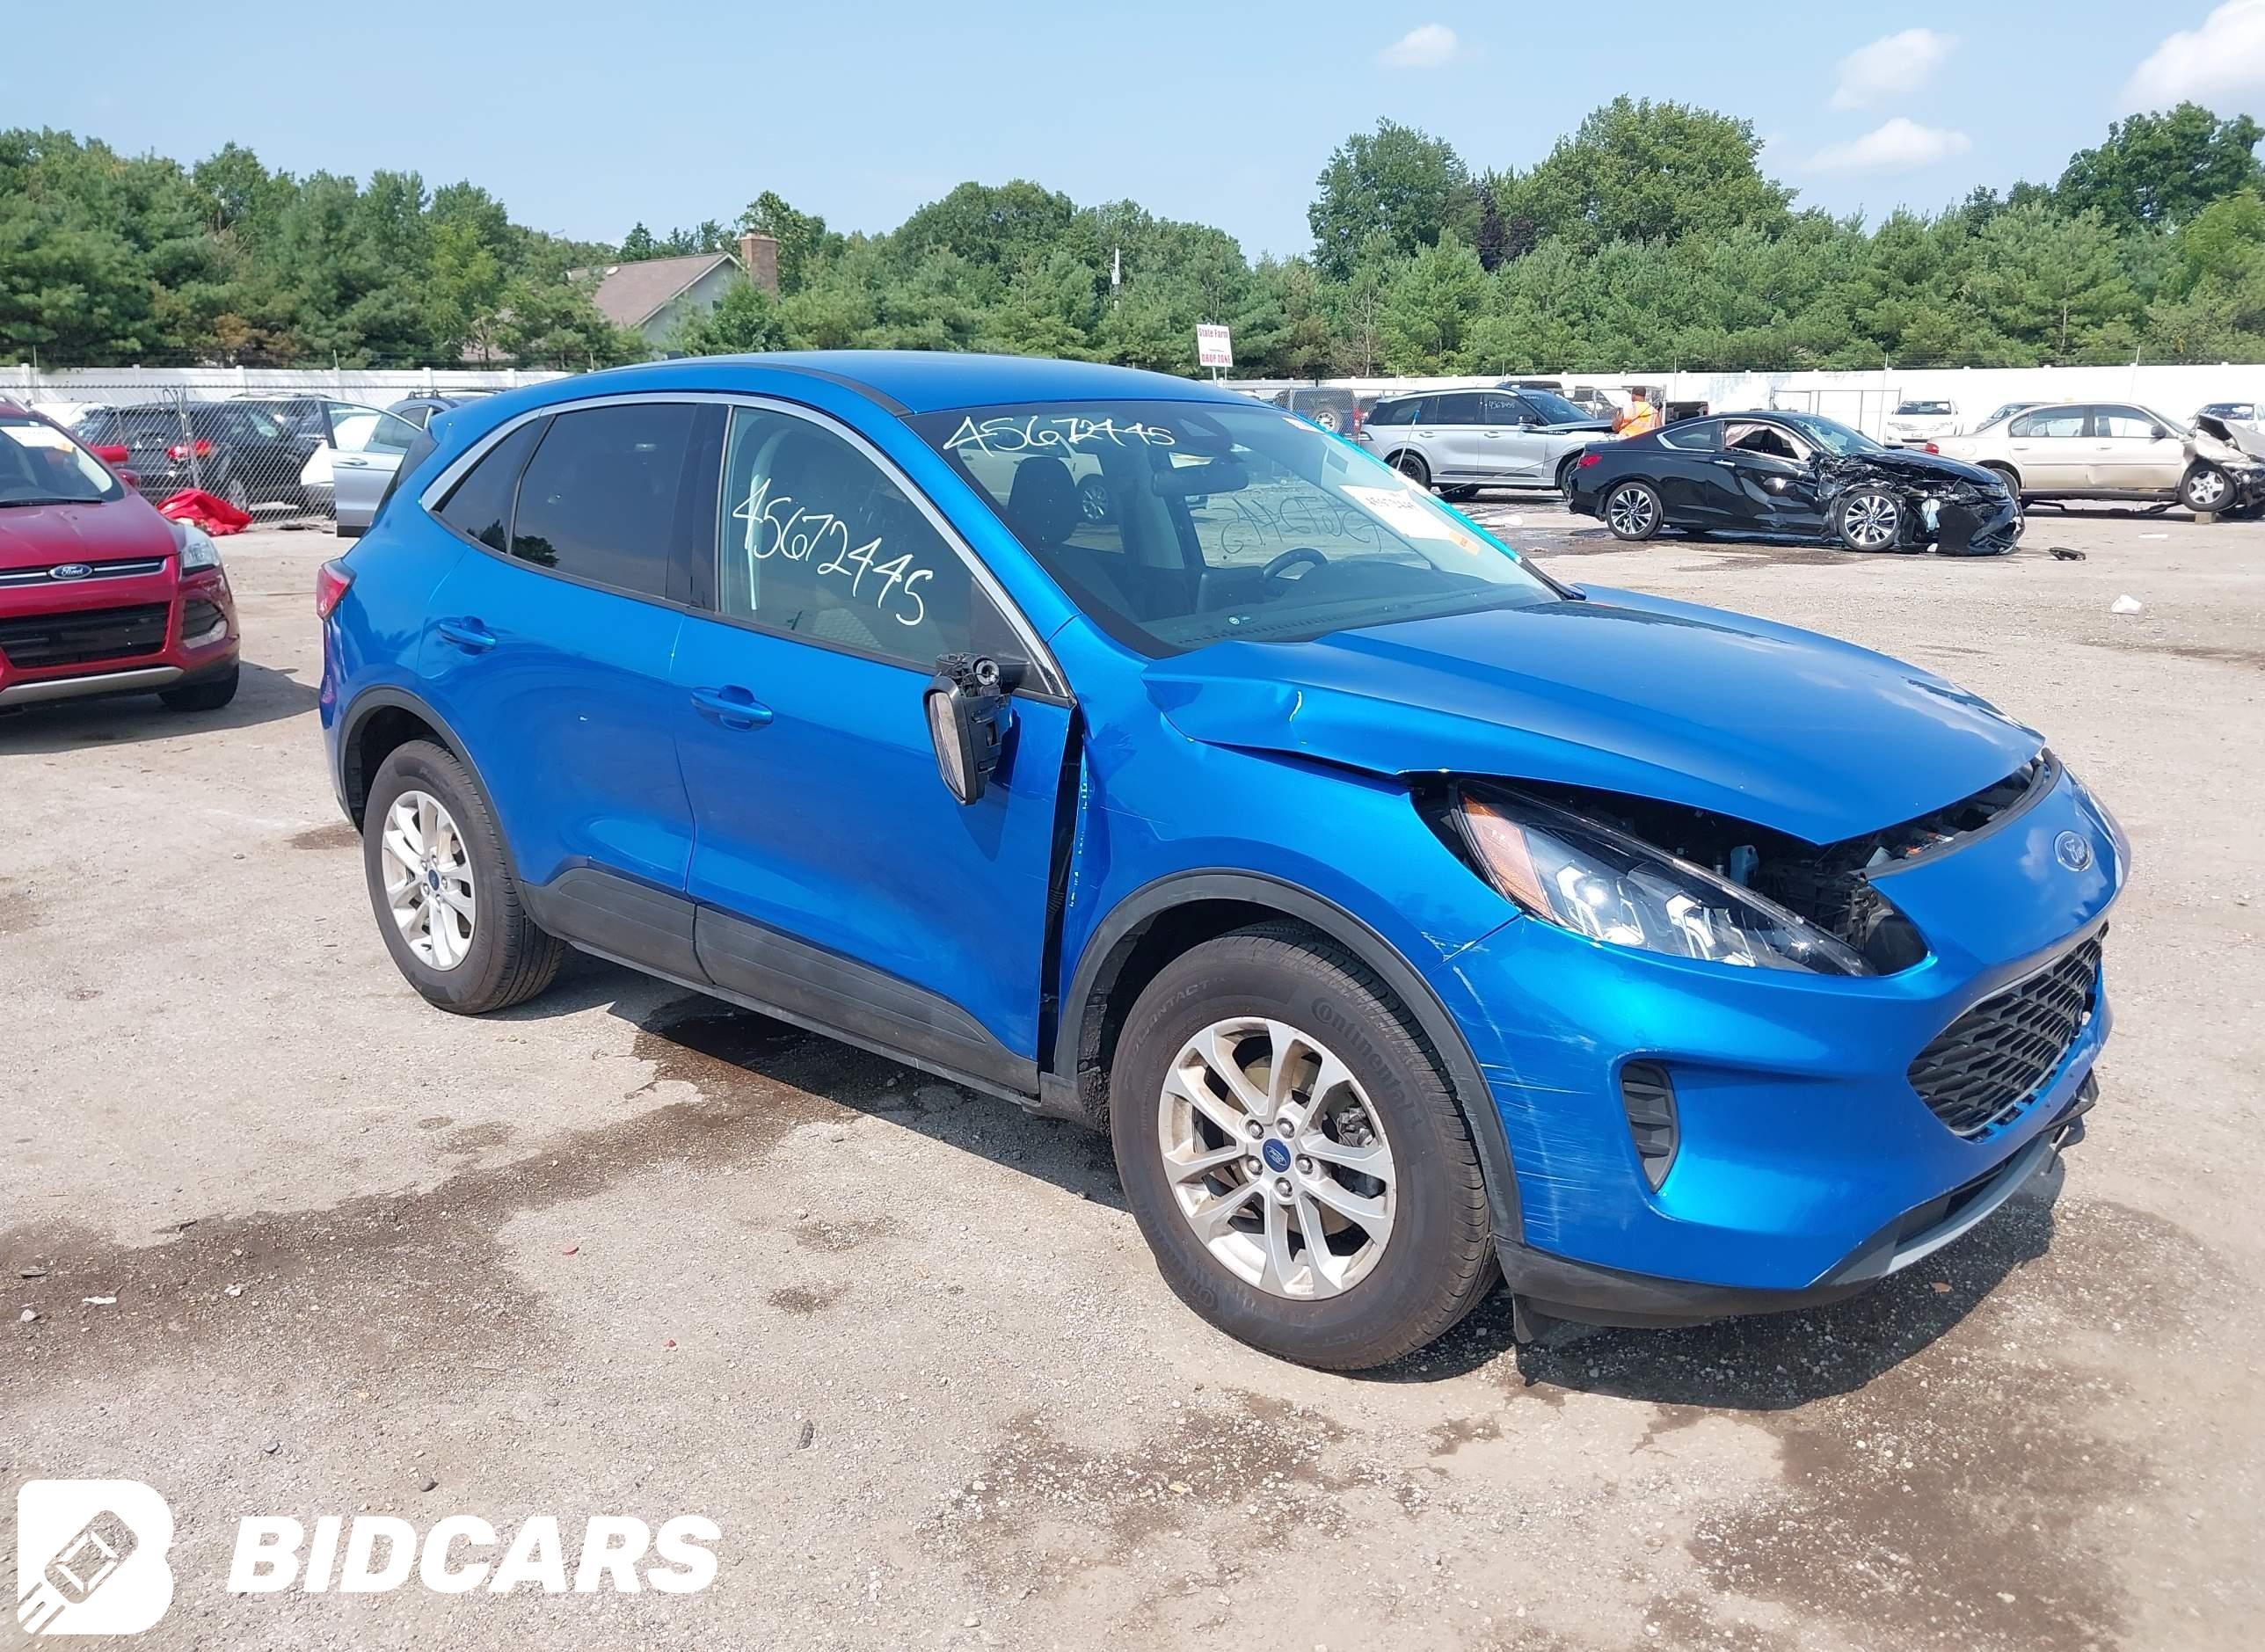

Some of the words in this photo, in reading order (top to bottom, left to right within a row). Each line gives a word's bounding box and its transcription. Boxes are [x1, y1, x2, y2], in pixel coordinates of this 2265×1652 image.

[1198, 328, 1213, 338] State
[1214, 329, 1228, 338] Farm
[62, 565, 84, 577] Ford
[732, 477, 934, 626] 45672445
[1311, 997, 1416, 1110] Continental
